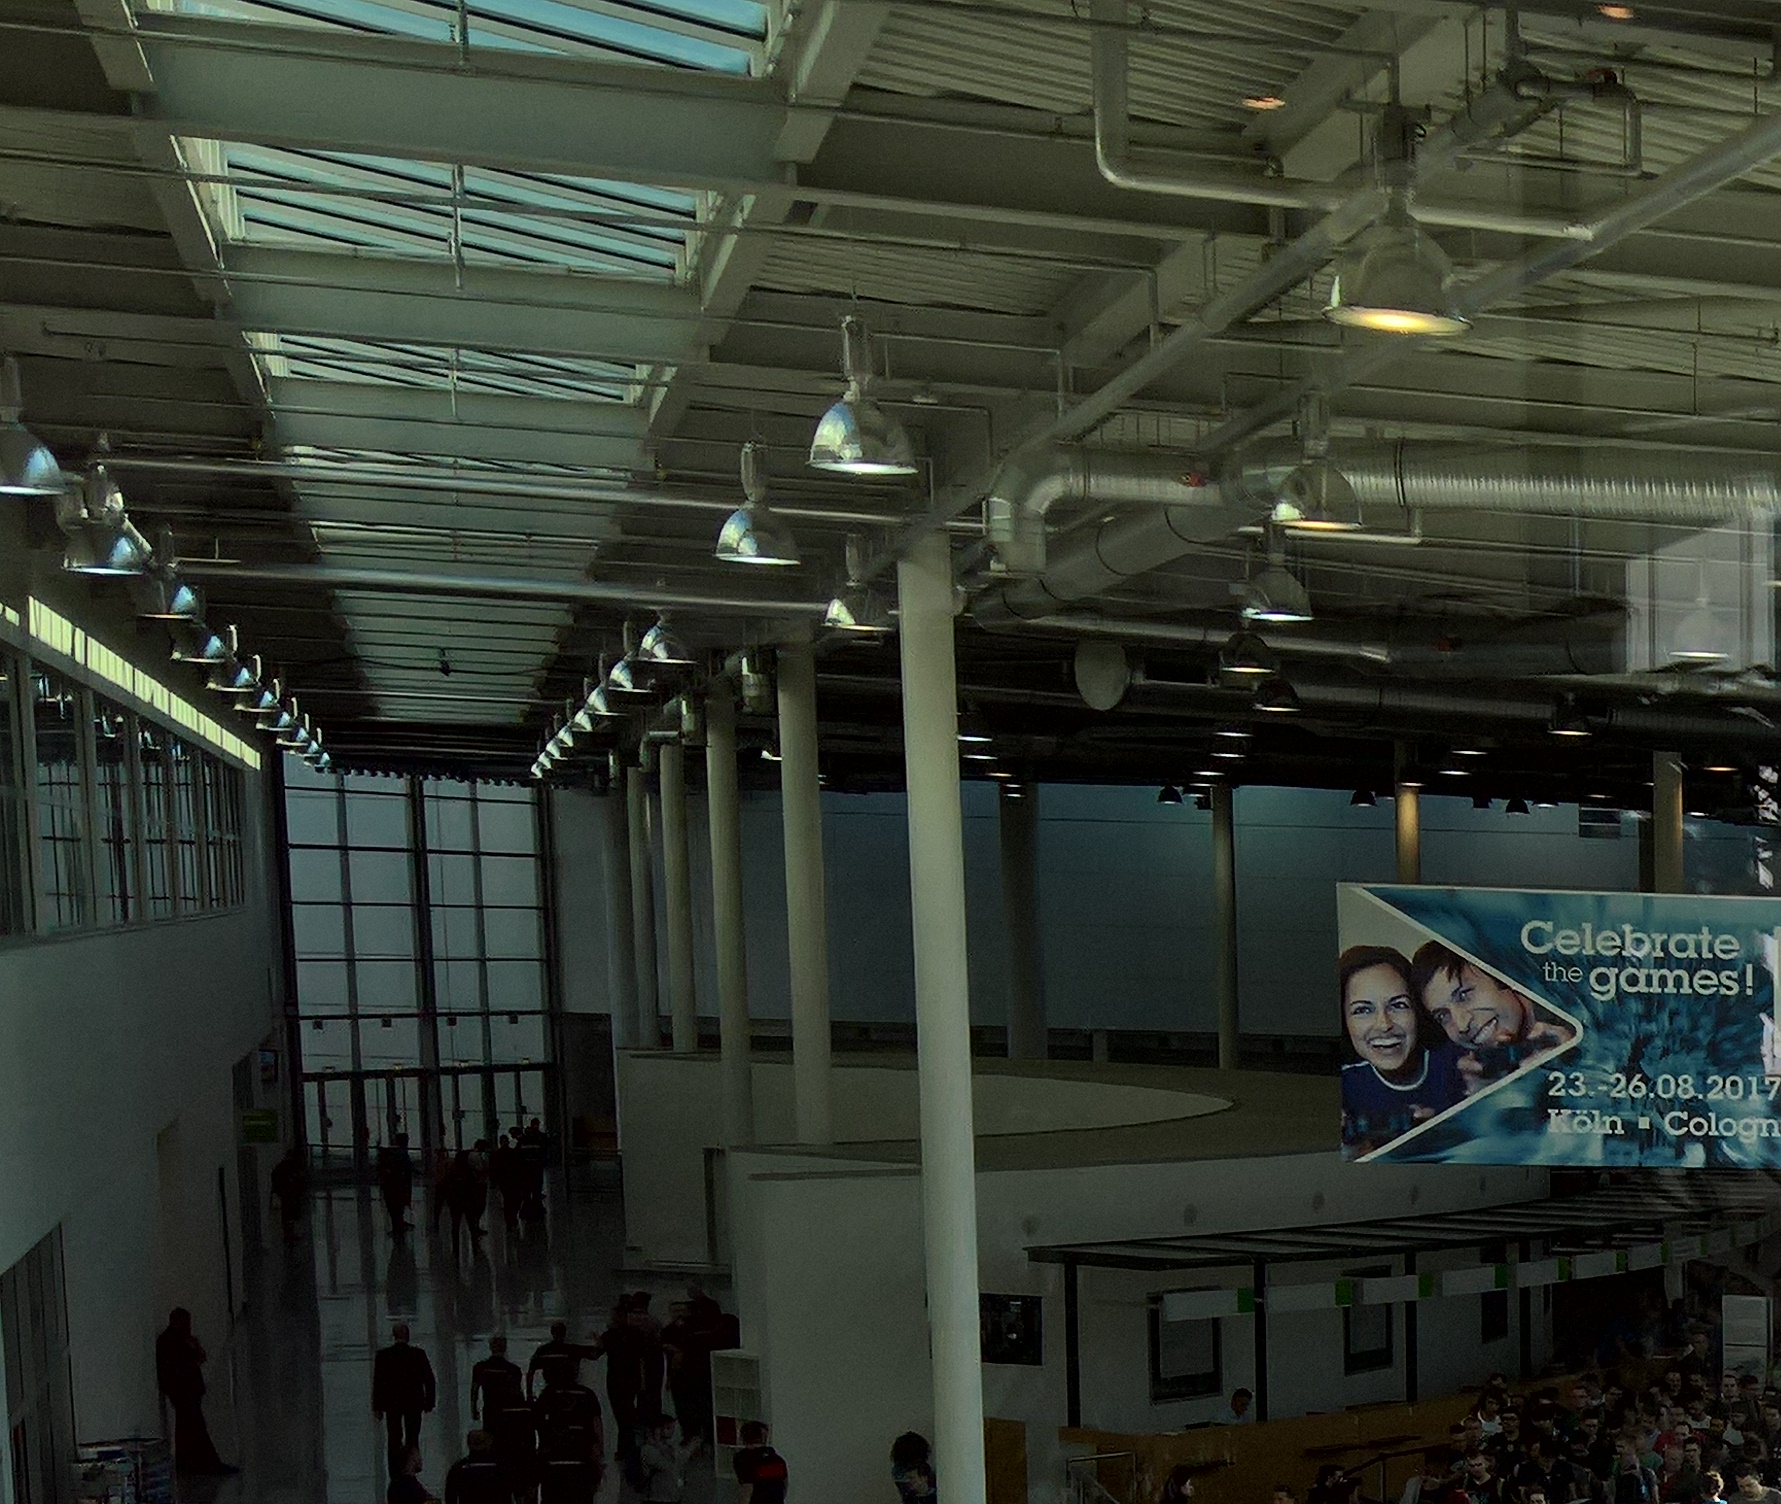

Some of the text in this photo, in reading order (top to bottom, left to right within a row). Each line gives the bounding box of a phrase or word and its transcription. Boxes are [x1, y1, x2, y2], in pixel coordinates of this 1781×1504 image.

[1521, 920, 1741, 960] Celebrate
[1542, 961, 1753, 1000] the games!
[1548, 1071, 1781, 1101] 23.-26.08.2017
[1548, 1108, 1625, 1135] Köln
